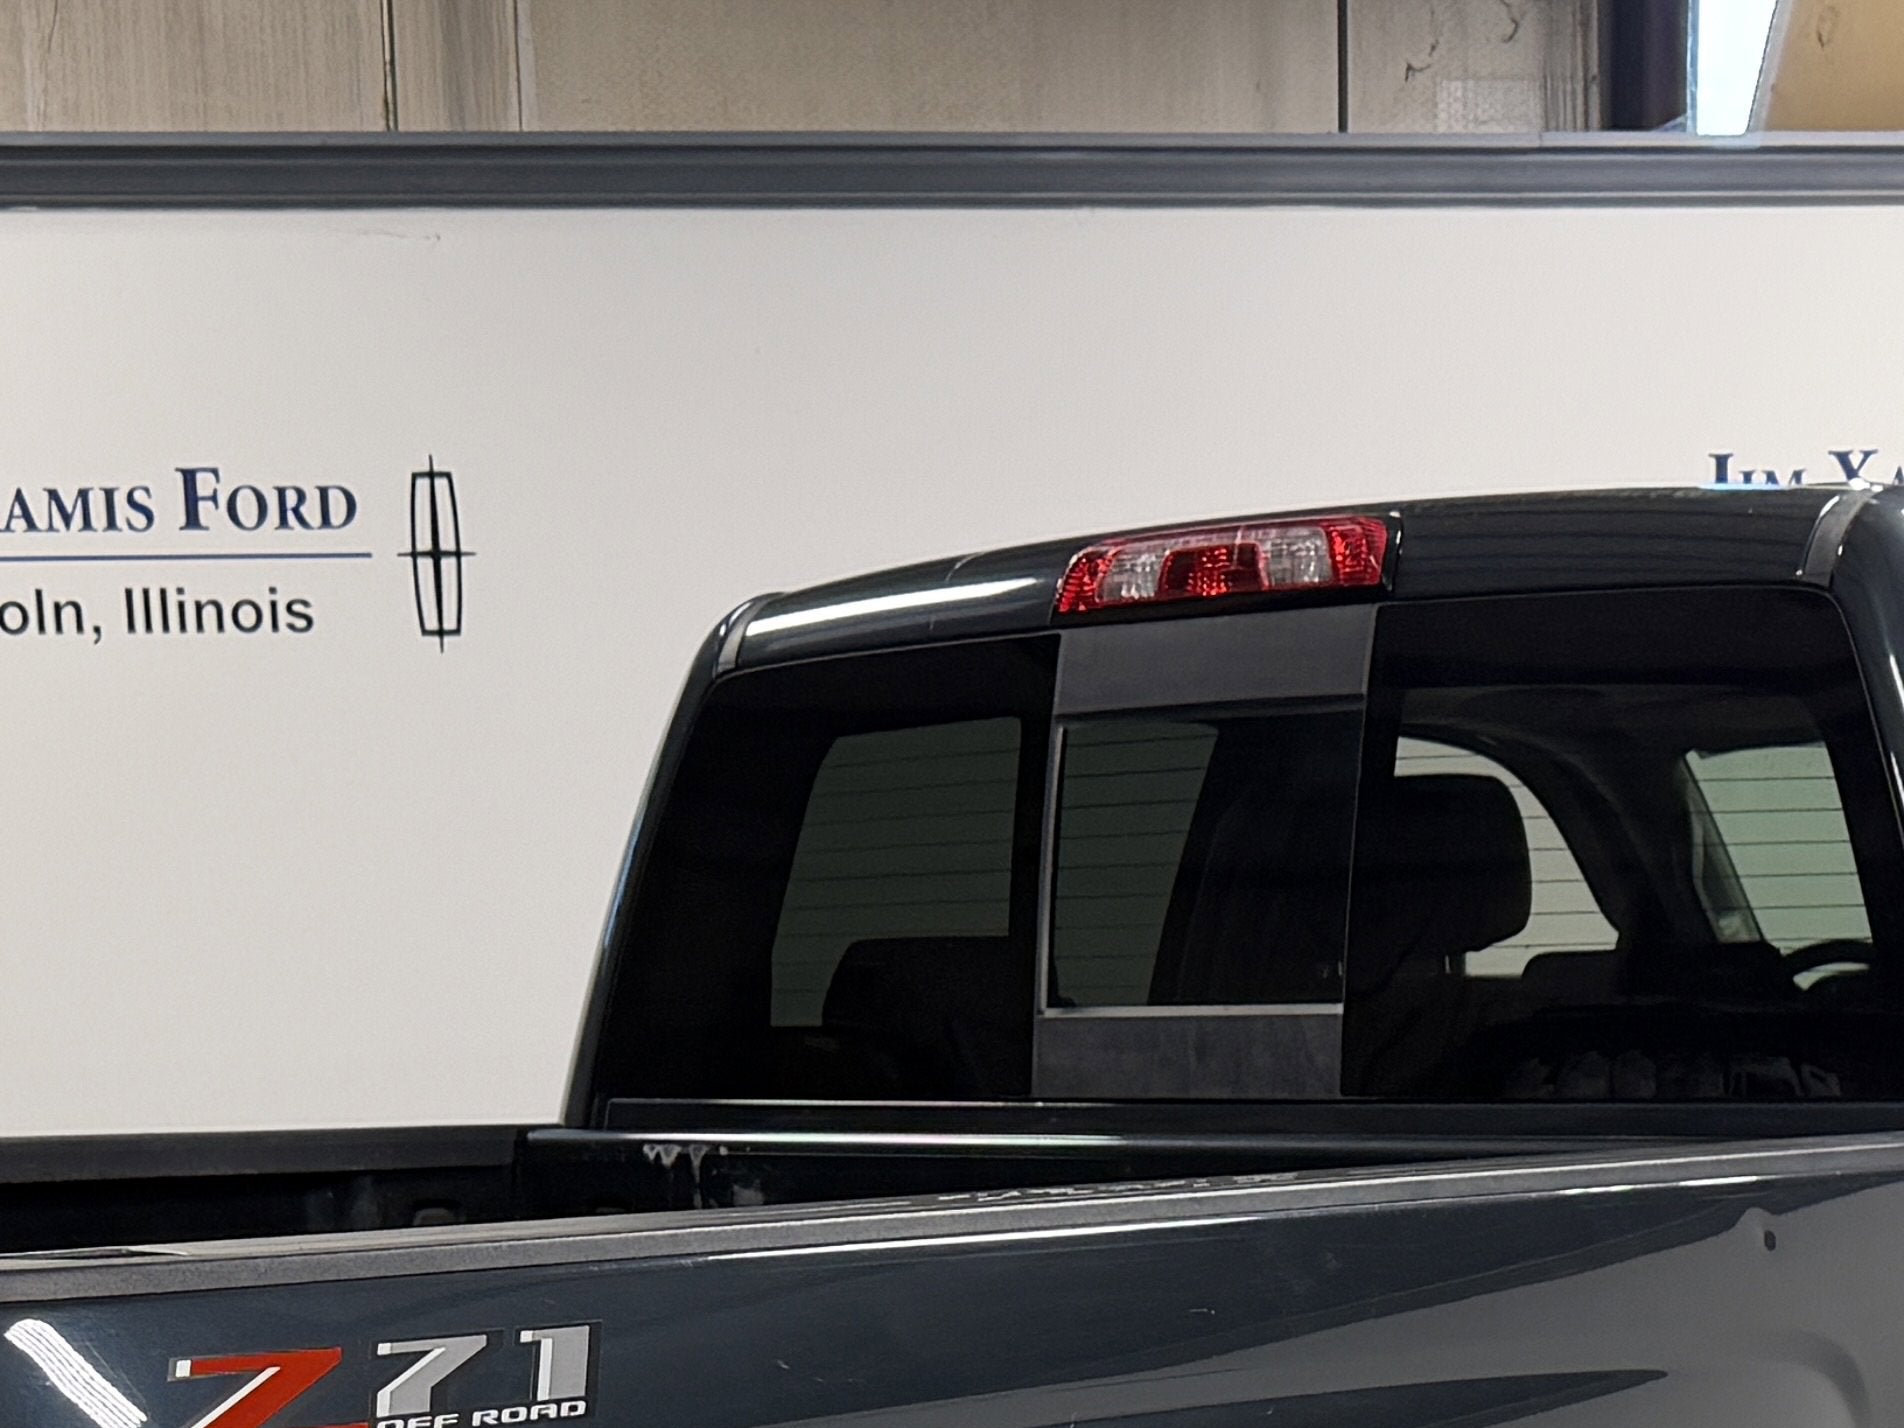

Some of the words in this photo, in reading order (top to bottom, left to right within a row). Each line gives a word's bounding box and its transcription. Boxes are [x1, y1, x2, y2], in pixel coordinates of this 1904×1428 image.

[175, 466, 359, 532] FORD
[125, 586, 315, 637] Illinois
[471, 1399, 588, 1428] ROAD
